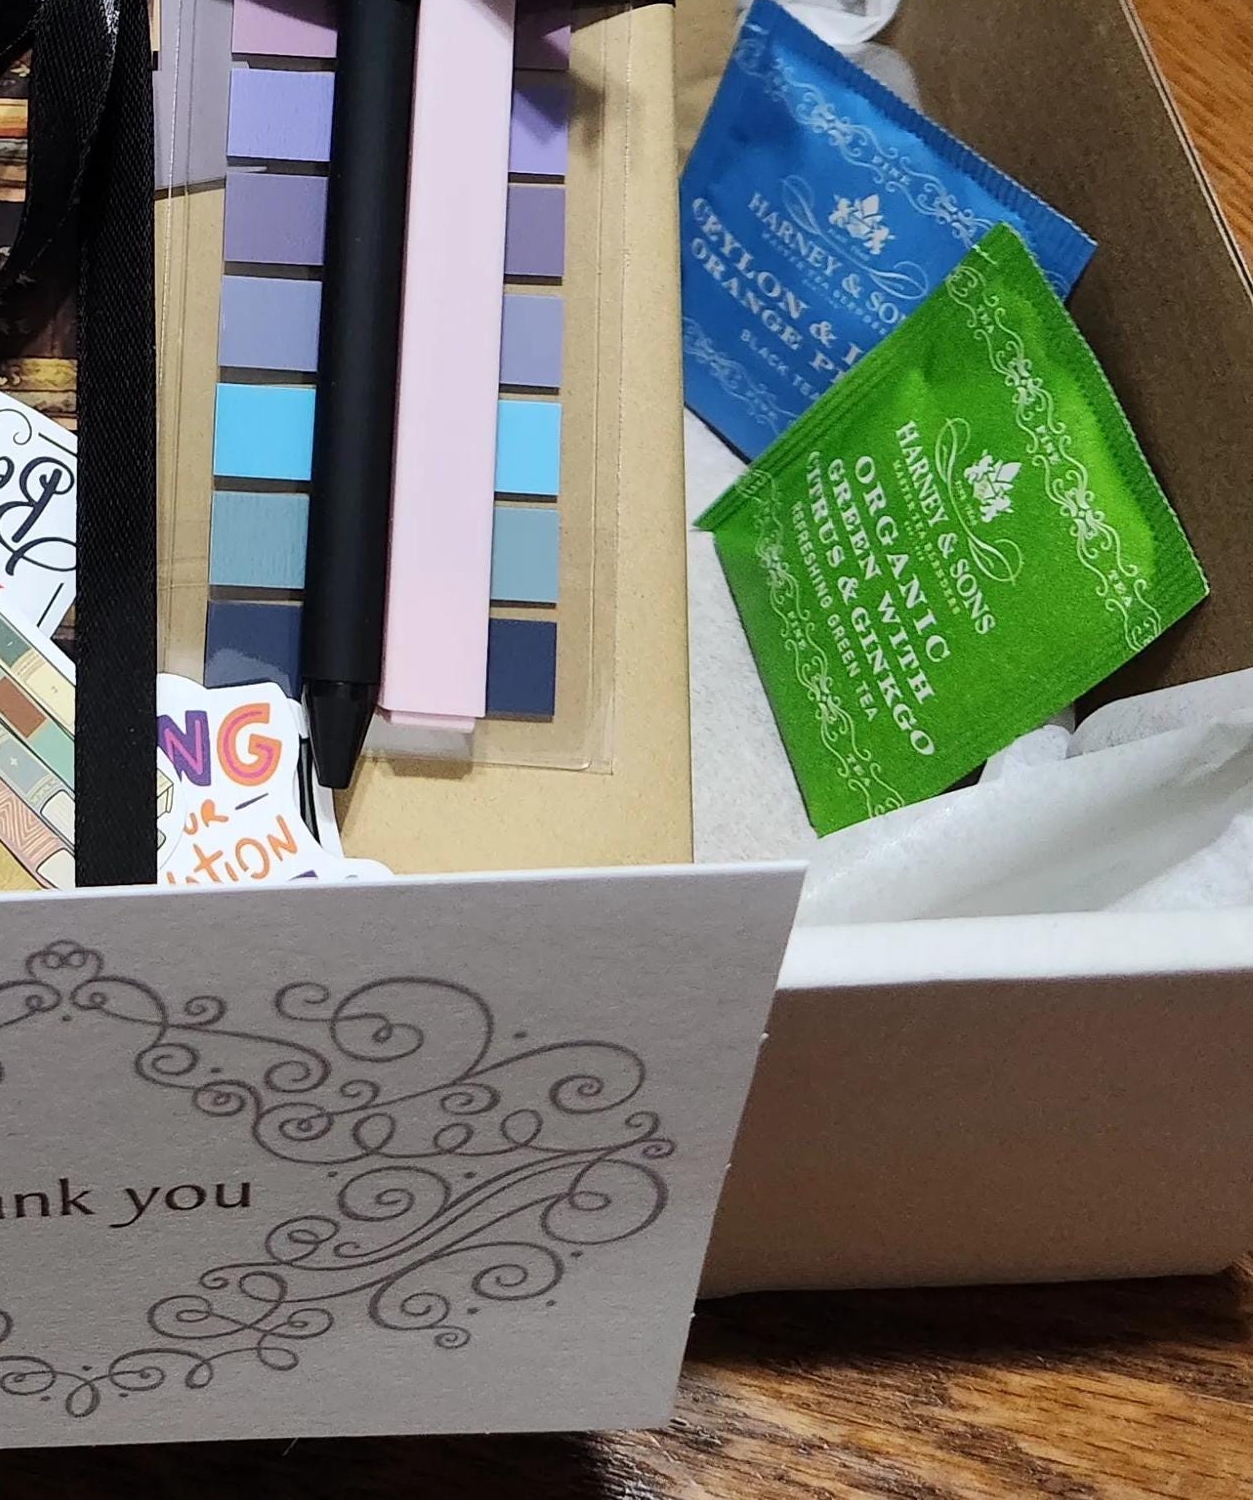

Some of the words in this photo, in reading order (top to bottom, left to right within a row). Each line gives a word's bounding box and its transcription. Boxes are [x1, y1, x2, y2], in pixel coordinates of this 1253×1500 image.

[691, 197, 810, 319] CEYLON
[809, 320, 838, 348] &
[691, 238, 803, 350] ORANGE
[747, 192, 841, 277] HARNEY
[841, 274, 862, 298] &
[866, 291, 907, 325] SO
[741, 329, 789, 376] BLACK
[792, 500, 833, 609] REFRESHING
[826, 613, 861, 678] GREEN
[856, 680, 879, 722] TEA
[806, 450, 844, 568] CITRUS
[837, 575, 859, 605] &
[851, 606, 936, 756] GINKGO
[827, 458, 883, 581] GREEN
[878, 589, 935, 705] WITH
[854, 455, 951, 663] ORGANIC
[896, 420, 949, 528] HARNEY
[937, 532, 959, 559] &
[950, 558, 996, 635] SONS
[108, 1181, 251, 1228] you
